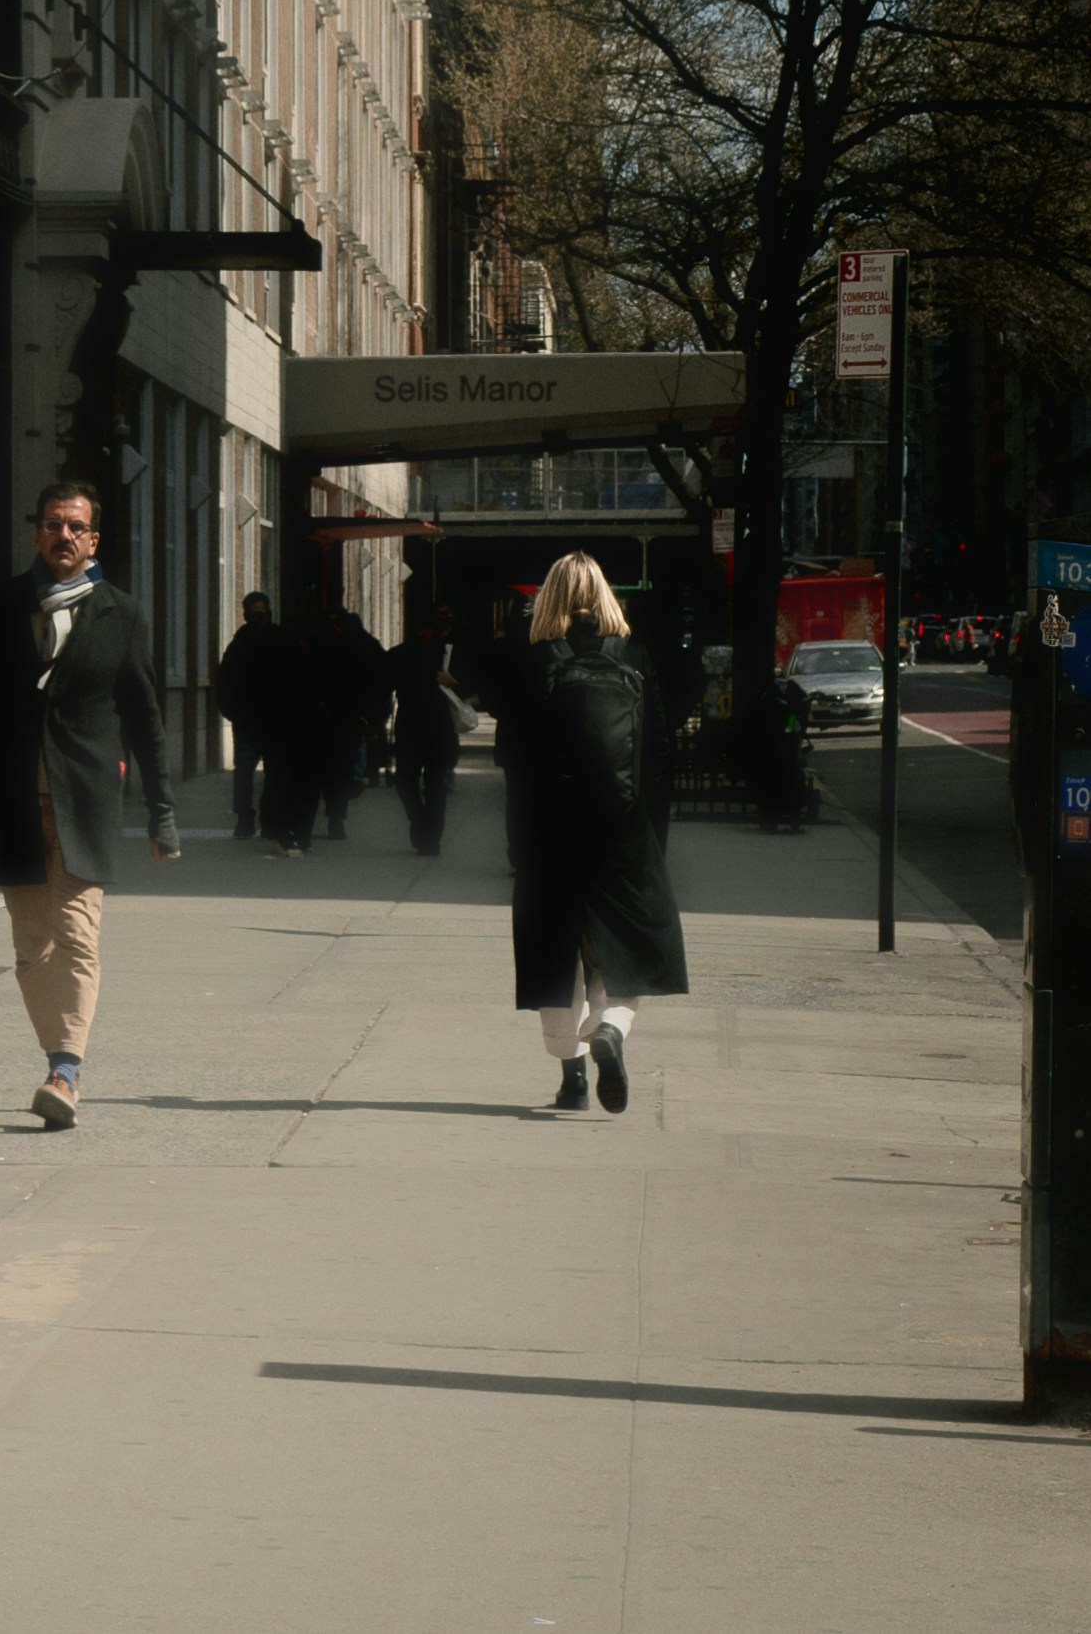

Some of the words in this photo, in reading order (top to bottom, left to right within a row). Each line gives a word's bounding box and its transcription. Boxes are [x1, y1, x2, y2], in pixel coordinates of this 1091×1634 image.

[844, 256, 856, 280] 3
[842, 291, 889, 303] COMMERCIAL
[842, 305, 877, 316] VEHICLES
[878, 304, 893, 315] ONL
[841, 343, 862, 354] Except
[863, 342, 886, 353] Sunday
[374, 374, 449, 403] Selis
[460, 375, 558, 402] Manor
